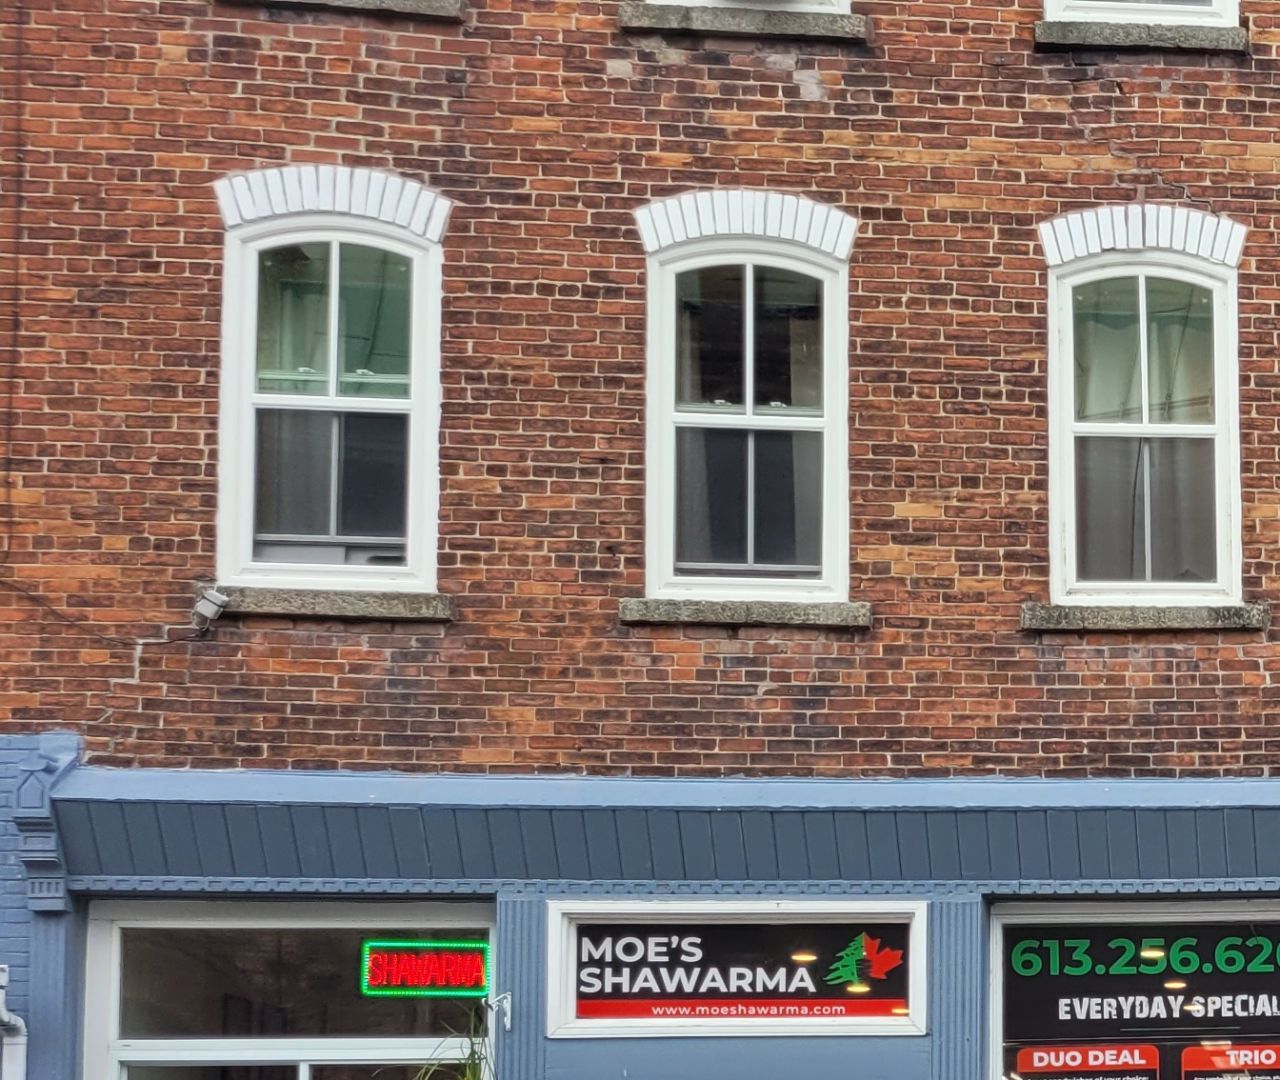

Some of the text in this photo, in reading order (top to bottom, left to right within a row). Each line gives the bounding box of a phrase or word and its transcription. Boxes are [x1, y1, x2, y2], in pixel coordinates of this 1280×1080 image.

[580, 935, 704, 964] MOE'S
[368, 952, 486, 987] SHAWARMA
[579, 967, 816, 994] SHAWARMA
[651, 1003, 847, 1016] www.moeshawarma.com
[1058, 995, 1185, 1020] EVERYDAY
[1032, 1049, 1147, 1067] DUO DEAL
[1225, 1049, 1277, 1065] TRIO
